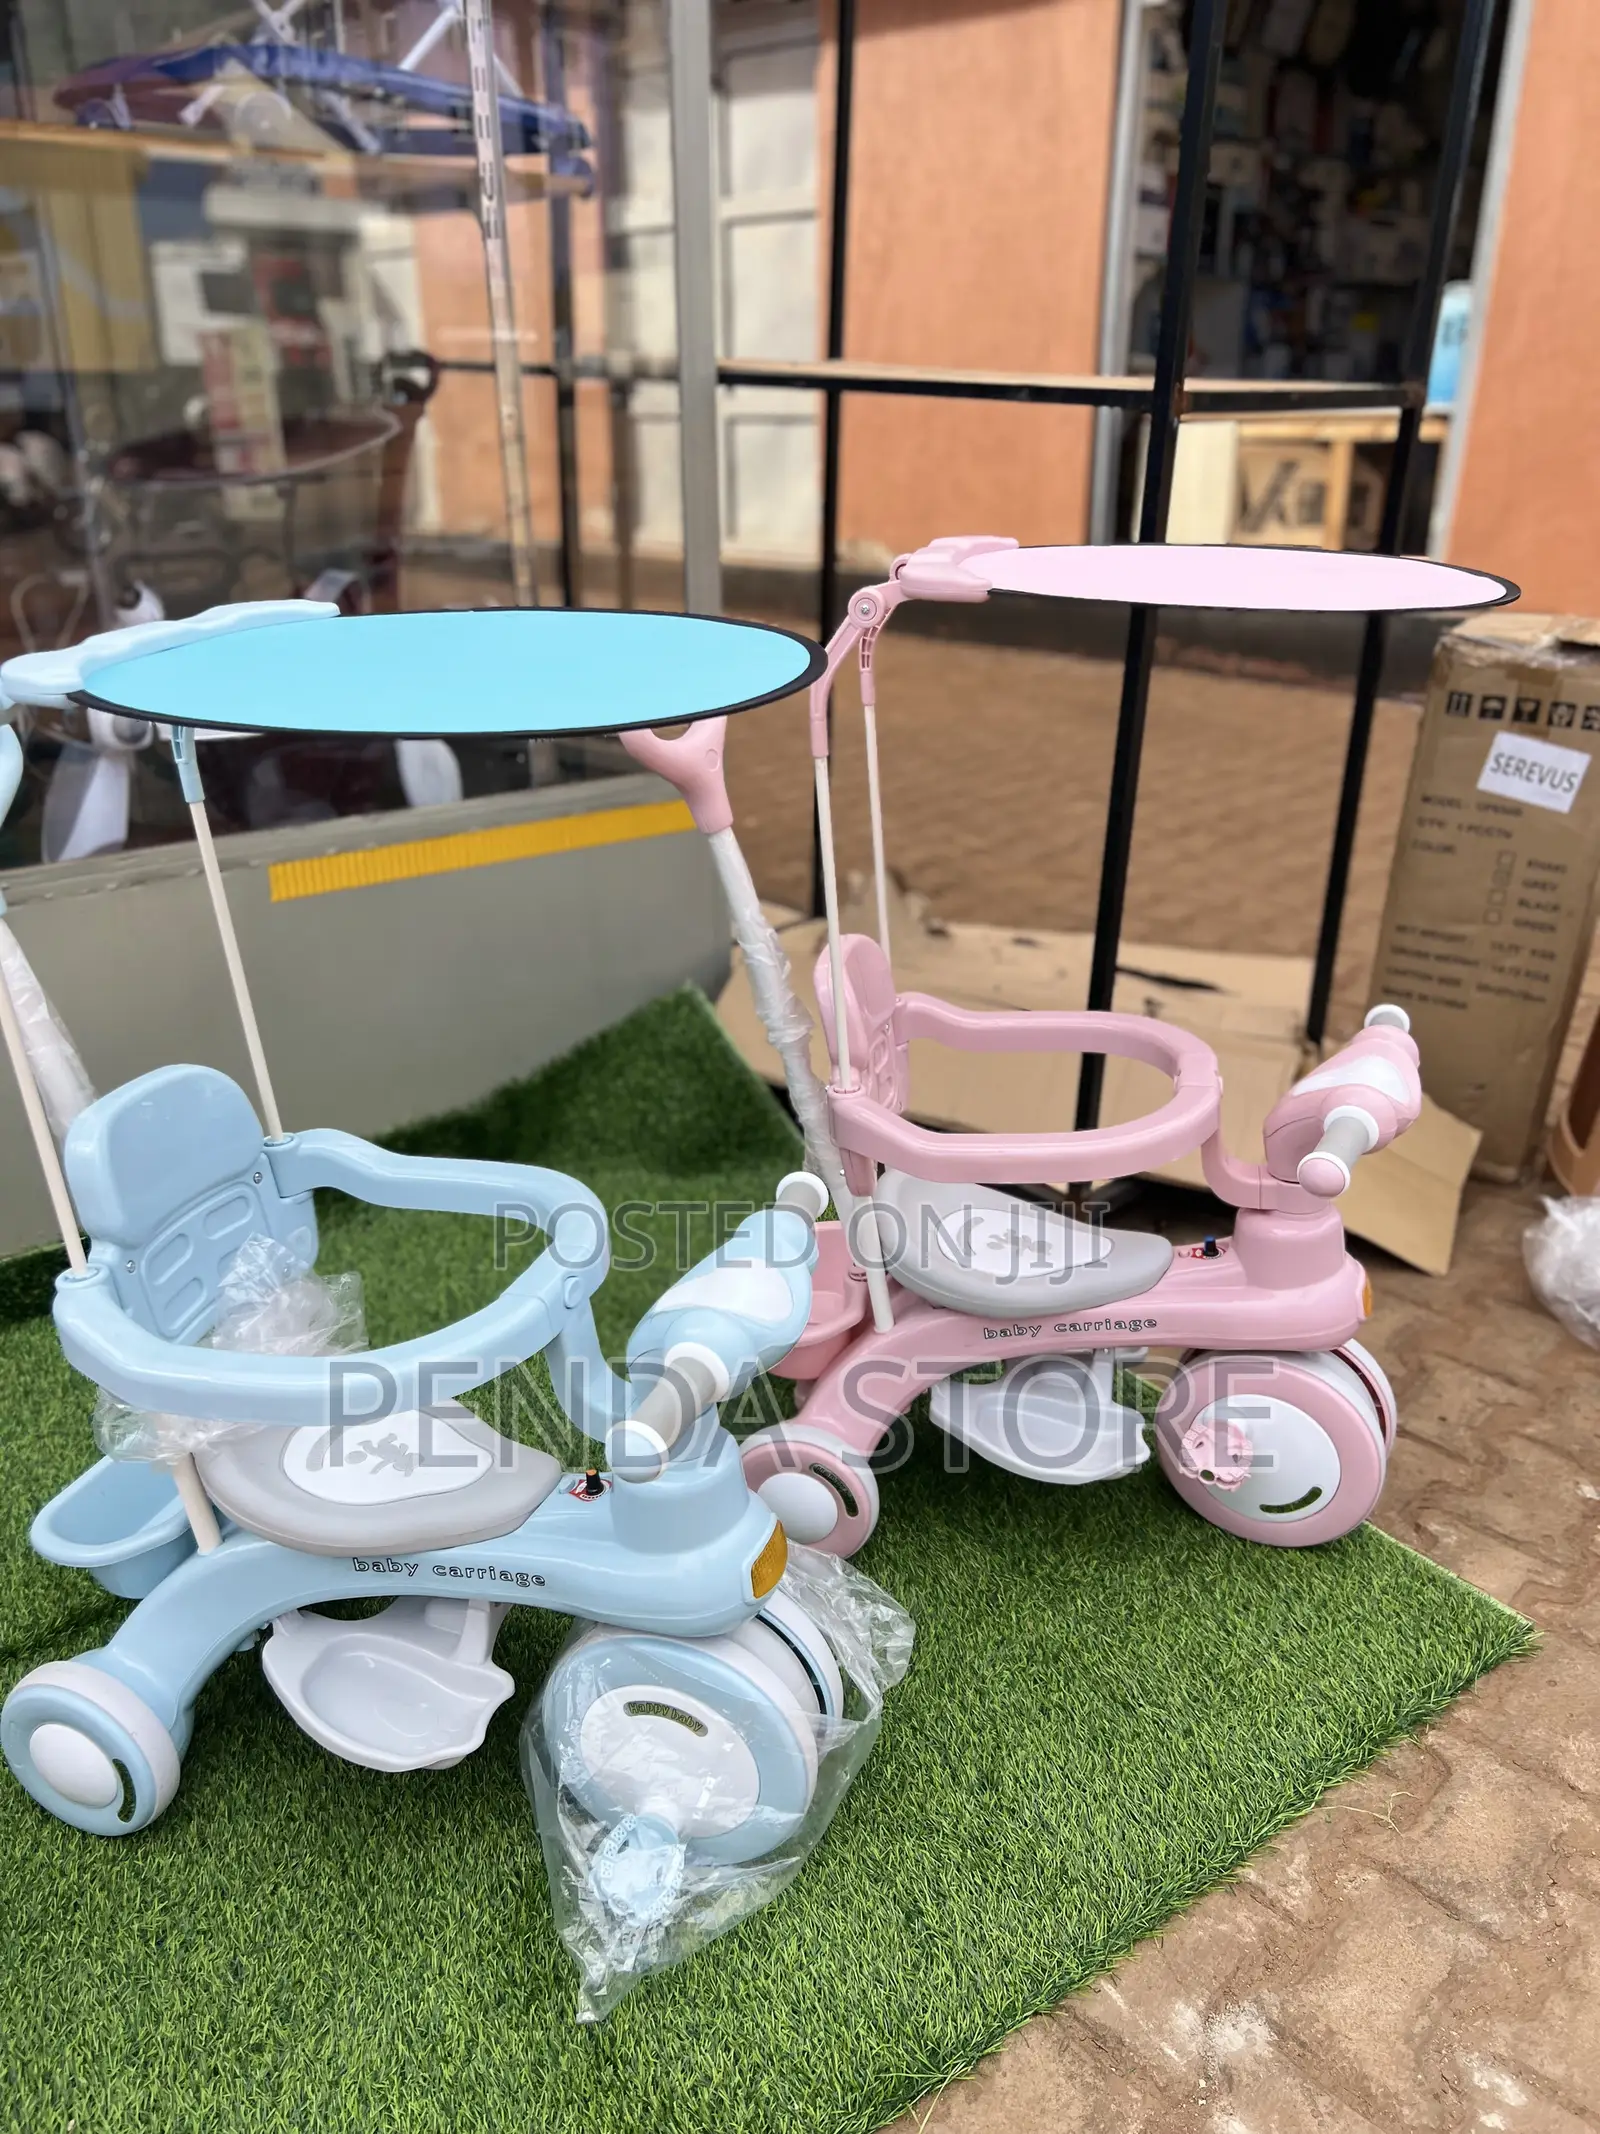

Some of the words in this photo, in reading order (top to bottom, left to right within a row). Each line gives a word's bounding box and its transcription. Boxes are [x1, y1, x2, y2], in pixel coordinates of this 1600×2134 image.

[1490, 752, 1579, 794] SEREVUS
[983, 1323, 1042, 1340] baby
[1053, 1317, 1158, 1333] carriage
[352, 1556, 419, 1577] baby
[432, 1564, 546, 1588] carriage
[627, 1702, 669, 1717] Happy
[670, 1708, 704, 1733] baby
